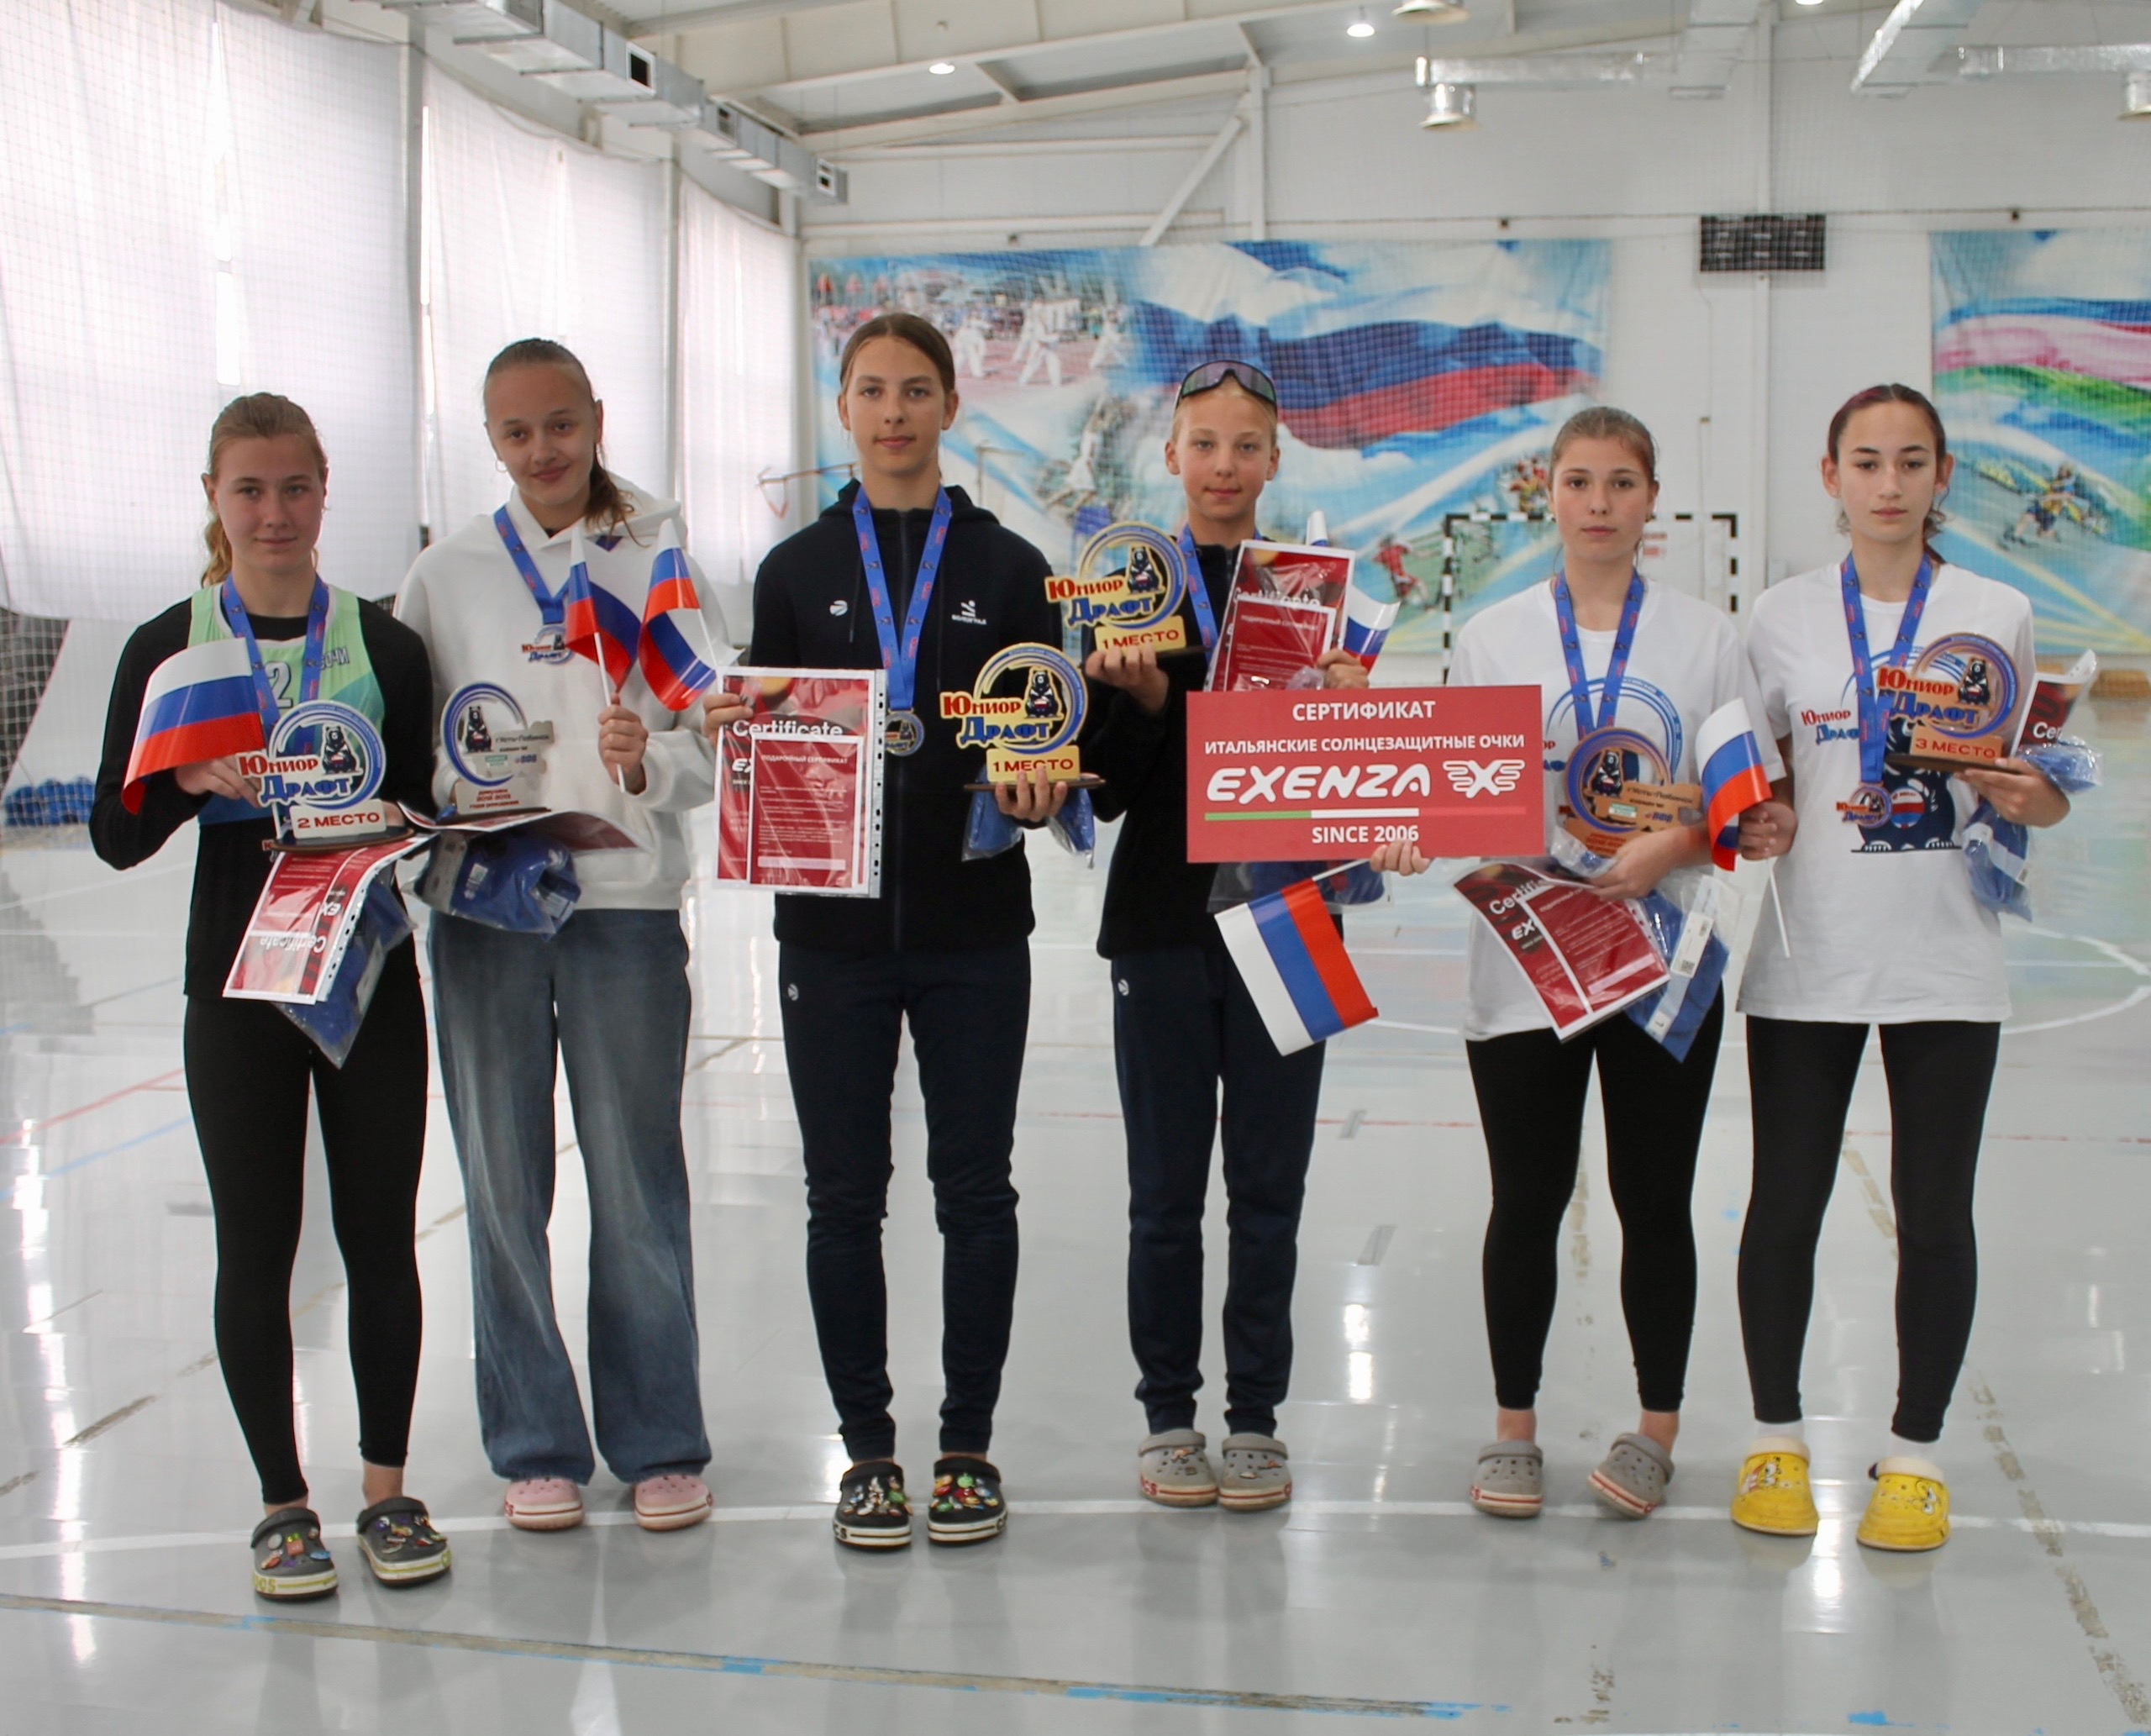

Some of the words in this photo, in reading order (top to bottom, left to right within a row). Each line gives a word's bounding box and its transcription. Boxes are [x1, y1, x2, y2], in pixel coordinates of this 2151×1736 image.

[1102, 639, 1109, 649] 1
[1113, 630, 1180, 647] МЕСТО
[264, 660, 293, 708] 2
[1292, 701, 1436, 721] СЕРТИФИКАТ
[1205, 739, 1317, 755] ИТАЛЬЯНСКИЕ
[1321, 735, 1475, 753] СОЛНЦЕЗАЩИТНЫЕ
[1480, 734, 1525, 748] ОЧКИ
[1915, 738, 1927, 750] 3
[1933, 740, 1996, 759] МЕСТО
[992, 761, 1000, 772] 1
[1005, 759, 1074, 772] МЕСТО
[1207, 763, 1431, 804] EXENZA
[297, 818, 312, 829] 2
[315, 812, 380, 827] МЕСТО
[1312, 826, 1369, 844] SINCE
[1374, 825, 1419, 843] 2006
